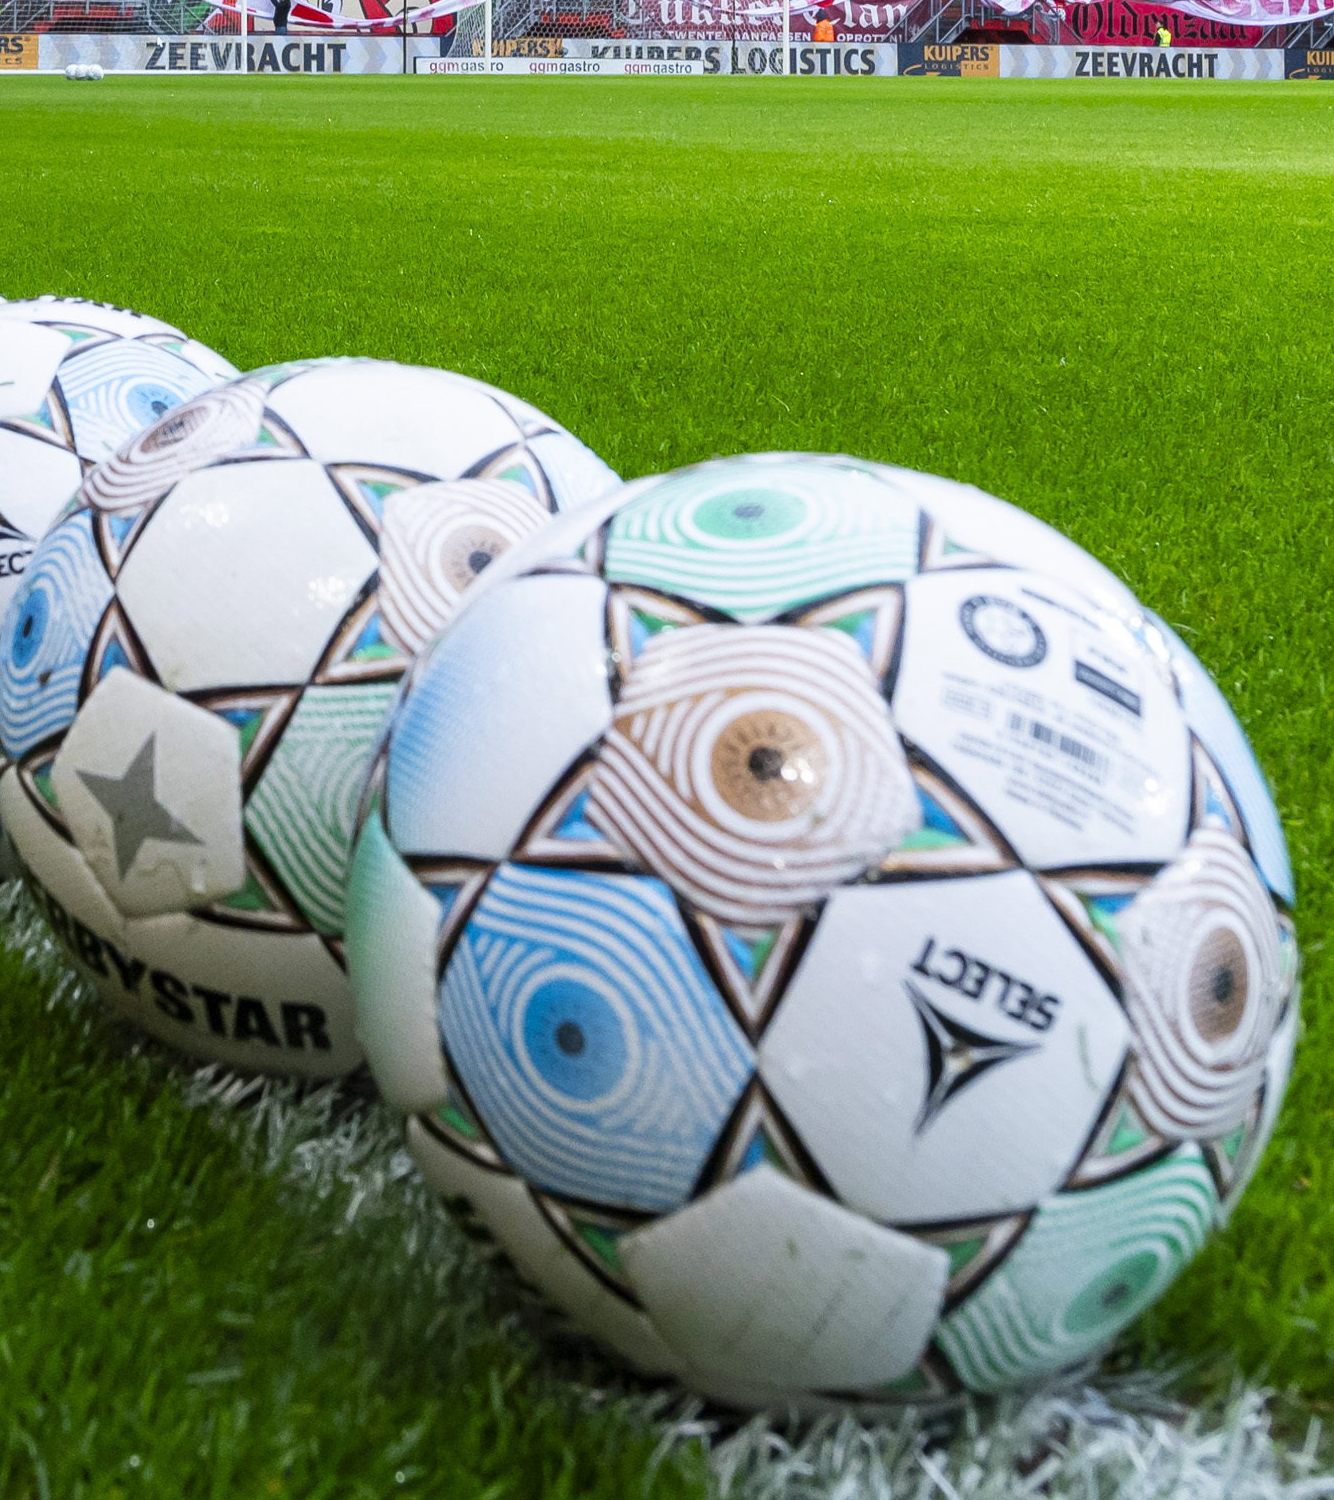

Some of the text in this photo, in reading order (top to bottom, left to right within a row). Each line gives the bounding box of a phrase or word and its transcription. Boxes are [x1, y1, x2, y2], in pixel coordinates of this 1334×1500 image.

[145, 42, 347, 73] ZEEVRACHT
[923, 44, 990, 61] KUIPERS
[1075, 51, 1219, 78] ZEEVRACHT
[43, 894, 333, 1052] BYSTAR
[912, 935, 1059, 1032] SELECT
